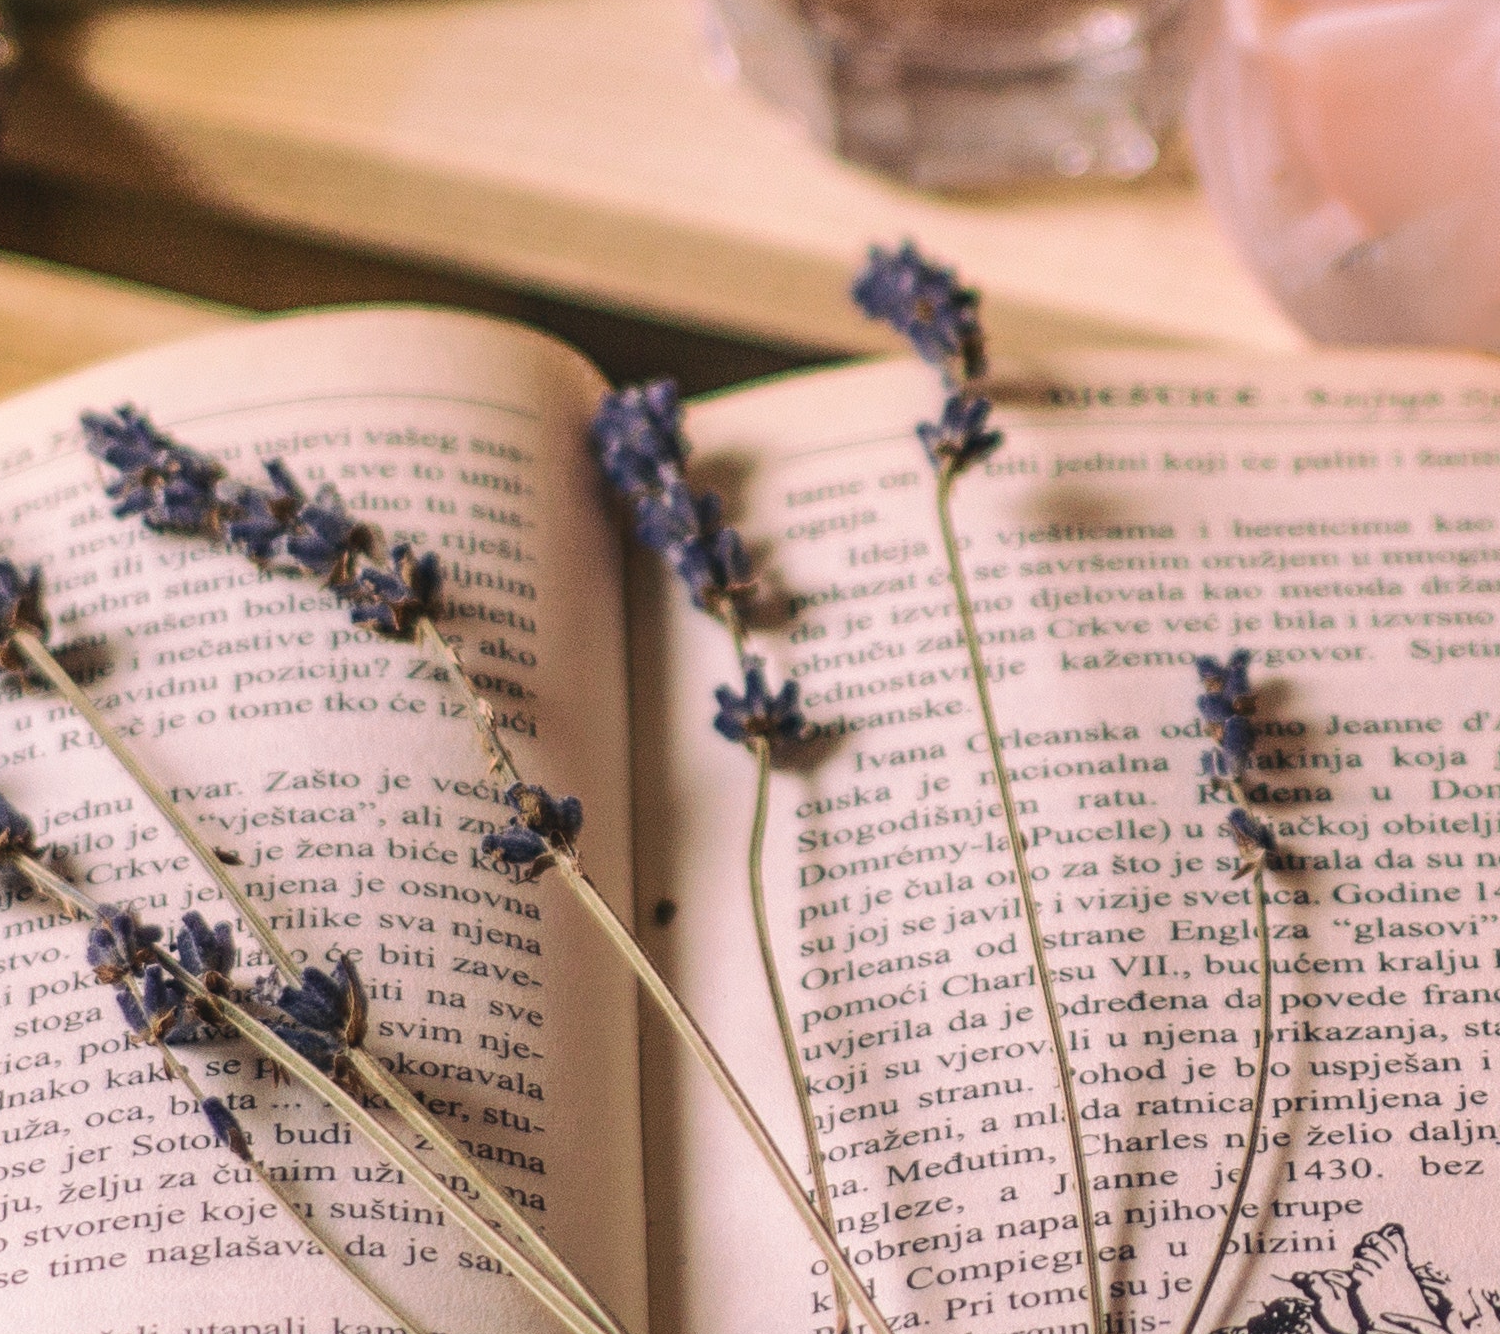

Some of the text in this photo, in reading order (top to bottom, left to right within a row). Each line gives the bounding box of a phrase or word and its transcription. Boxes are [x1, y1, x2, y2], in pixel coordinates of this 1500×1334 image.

[1325, 712, 1444, 736] Jeanne
[1391, 744, 1470, 774] koja
[1370, 786, 1394, 802] u
[1372, 845, 1416, 869] da
[1425, 854, 1465, 869] su
[1331, 879, 1462, 904] Godine
[1377, 947, 1481, 978] kralju
[1279, 982, 1407, 1015] povede
[1308, 1050, 1463, 1083] uspješan
[1481, 1047, 1492, 1071] i
[1271, 1086, 1444, 1119] primljena
[1453, 1082, 1489, 1113] je
[1305, 1120, 1394, 1145] želio
[1284, 1154, 1384, 1181] 1430.
[1419, 1152, 1485, 1176] bez
[48, 1251, 128, 1278] time
[146, 1232, 324, 1266] naglašava
